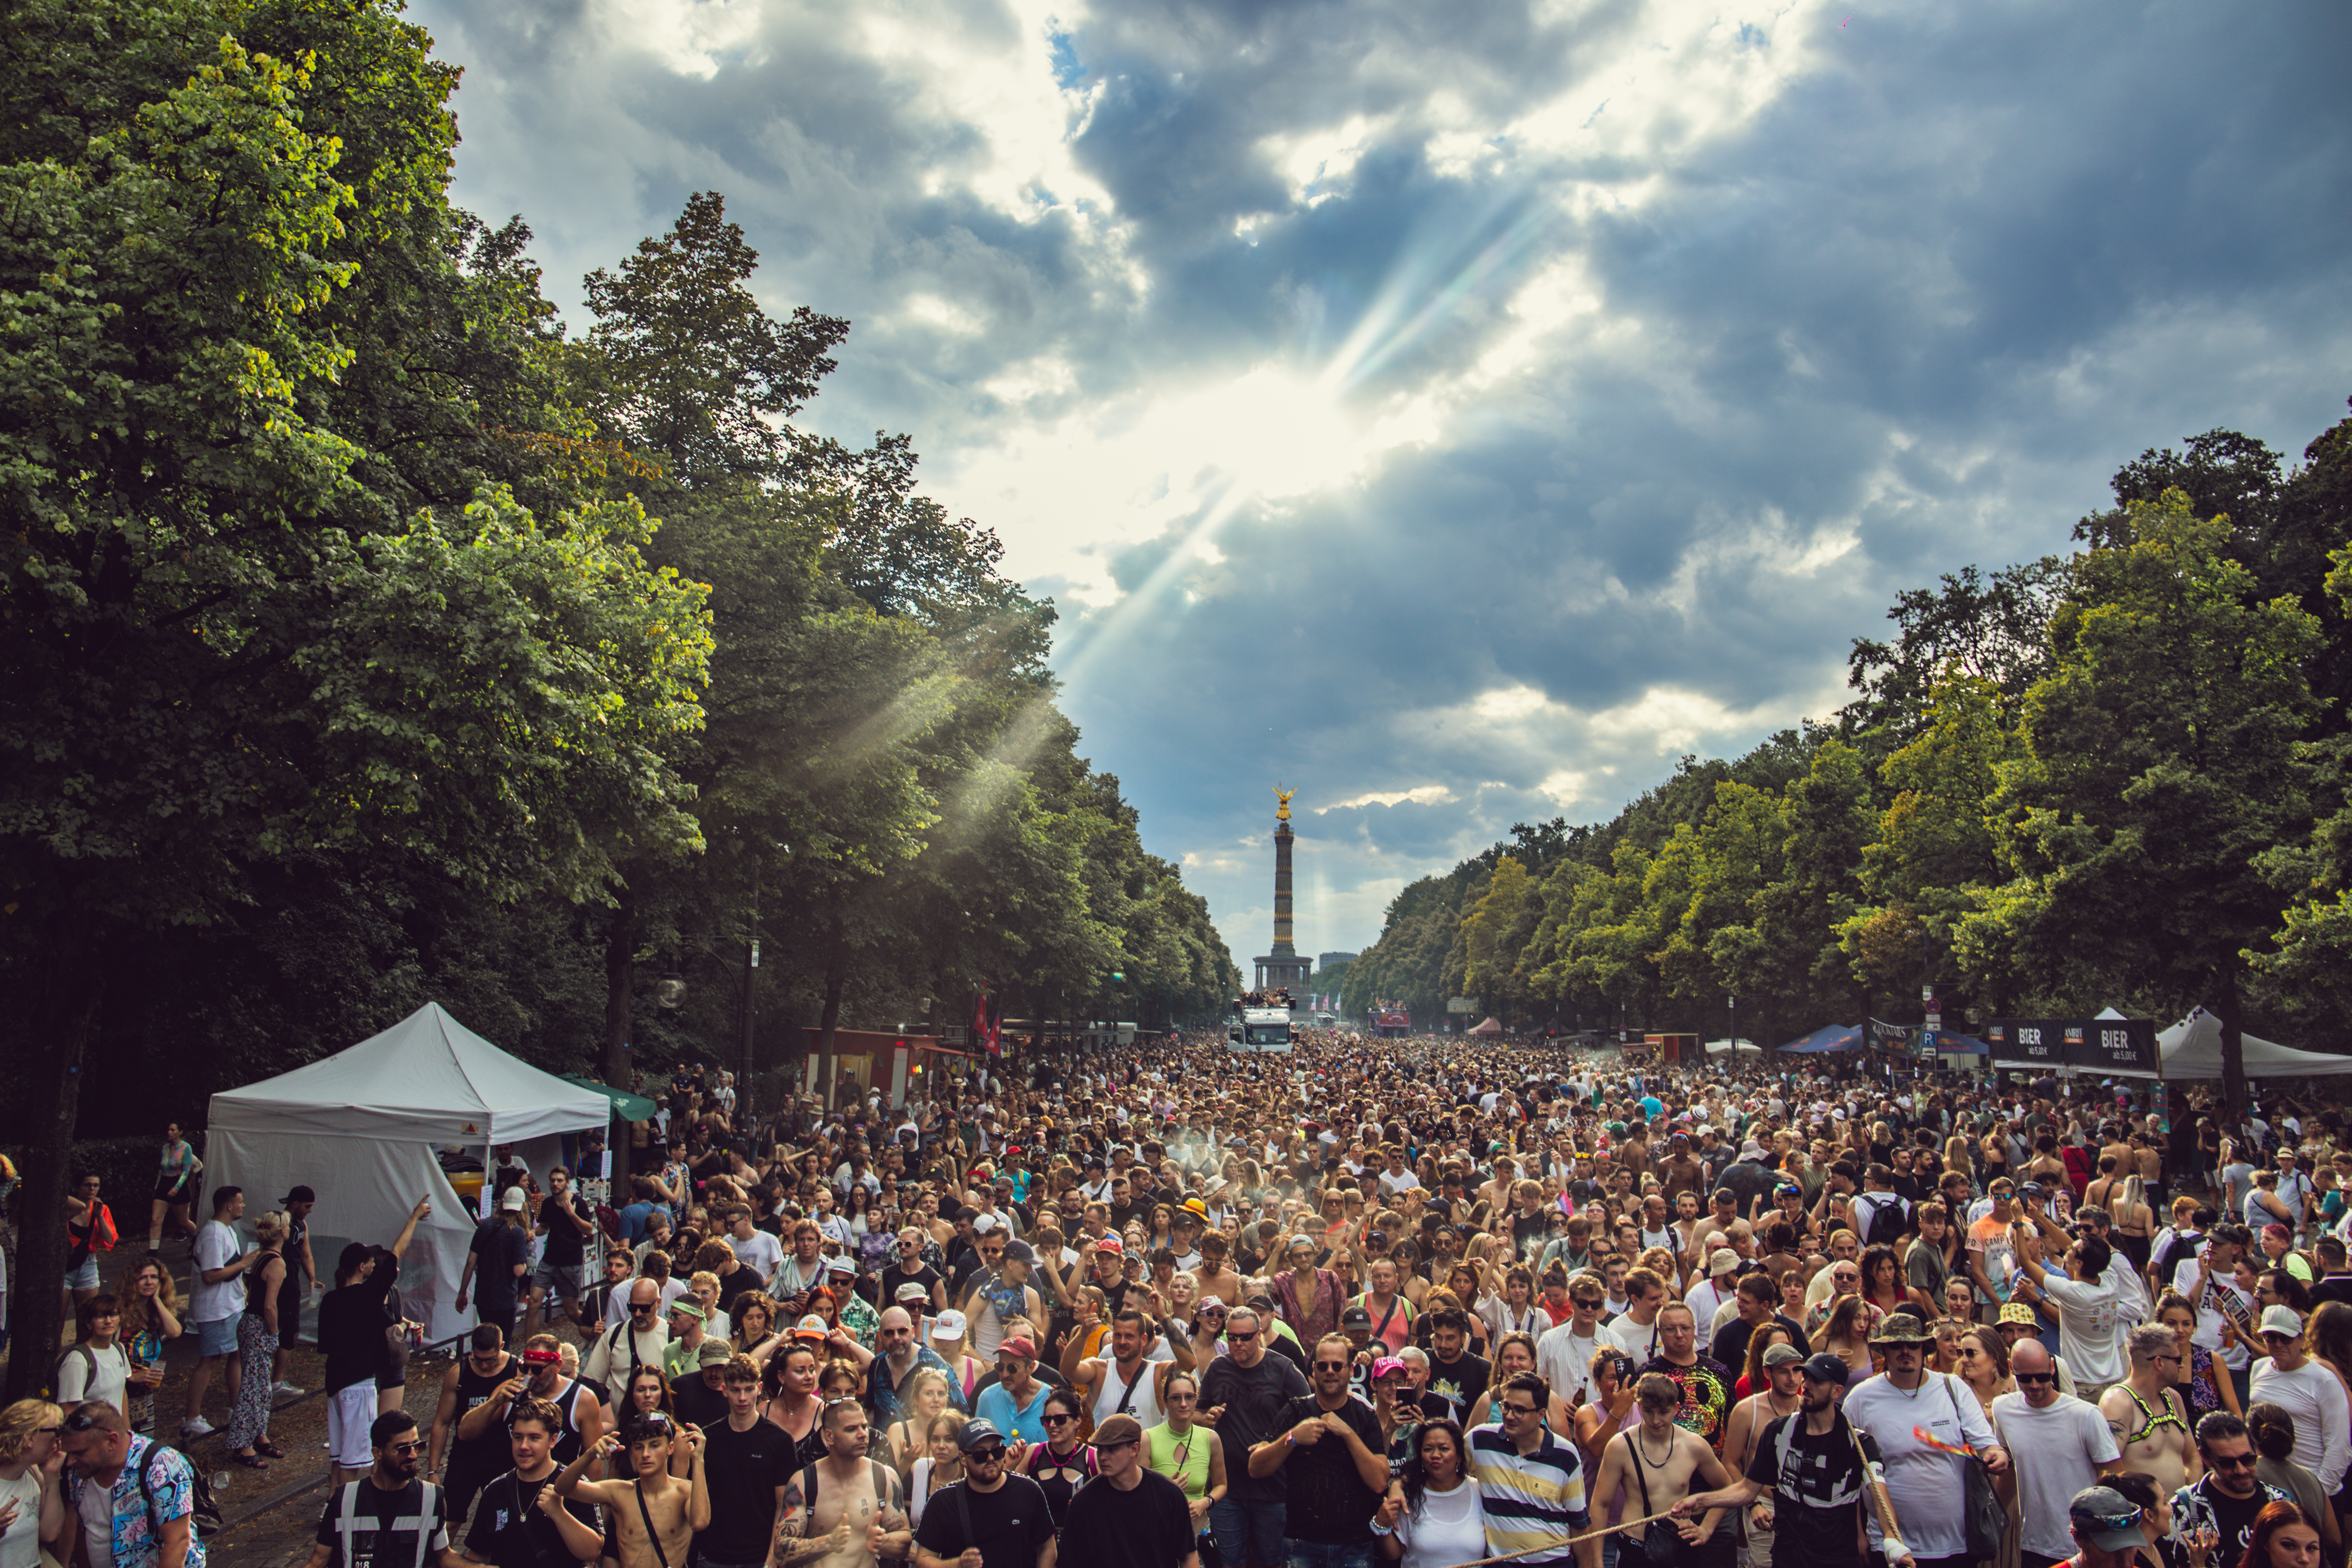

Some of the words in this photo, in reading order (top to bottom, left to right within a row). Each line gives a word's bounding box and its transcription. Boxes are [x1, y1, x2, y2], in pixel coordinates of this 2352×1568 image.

[1872, 1023, 1906, 1038] COCKTAILS
[2064, 1027, 2083, 1038] AMRIT
[1924, 1033, 1932, 1044] P
[2019, 1028, 2041, 1045] BIER
[2101, 1030, 2129, 1049] BIER
[2028, 1046, 2035, 1055] ab
[2113, 1050, 2120, 1060] ab
[1985, 1237, 2004, 1247] CAMP
[468, 1396, 488, 1406] JUST
[126, 1516, 148, 1541] POP
